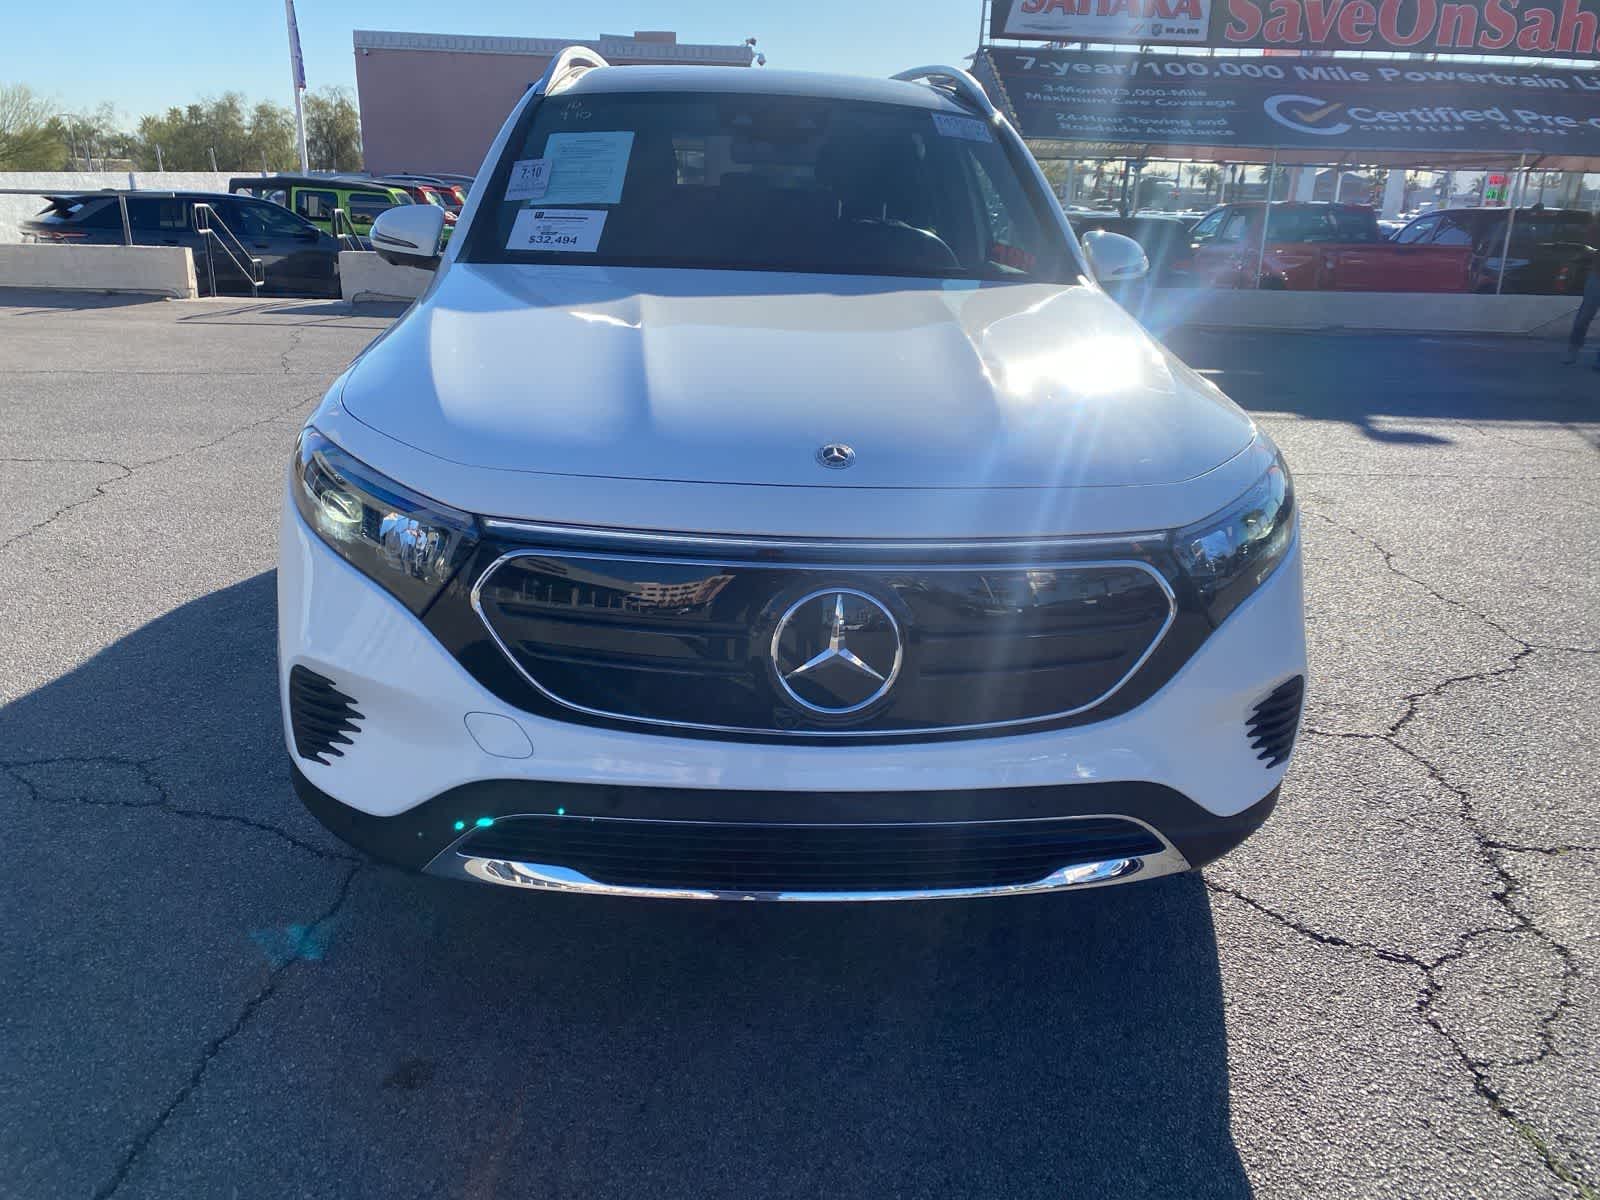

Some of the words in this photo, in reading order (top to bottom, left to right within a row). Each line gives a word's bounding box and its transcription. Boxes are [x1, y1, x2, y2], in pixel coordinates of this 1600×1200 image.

[1224, 0, 1600, 54] SaveOnSah
[1296, 66, 1370, 81] Mile
[1378, 68, 1569, 89] Powertrain
[1129, 116, 1192, 127] Towing
[1196, 118, 1229, 127] and
[1348, 106, 1509, 124] Certified
[1146, 126, 1237, 137] Assistance
[528, 234, 578, 246] $32,494
